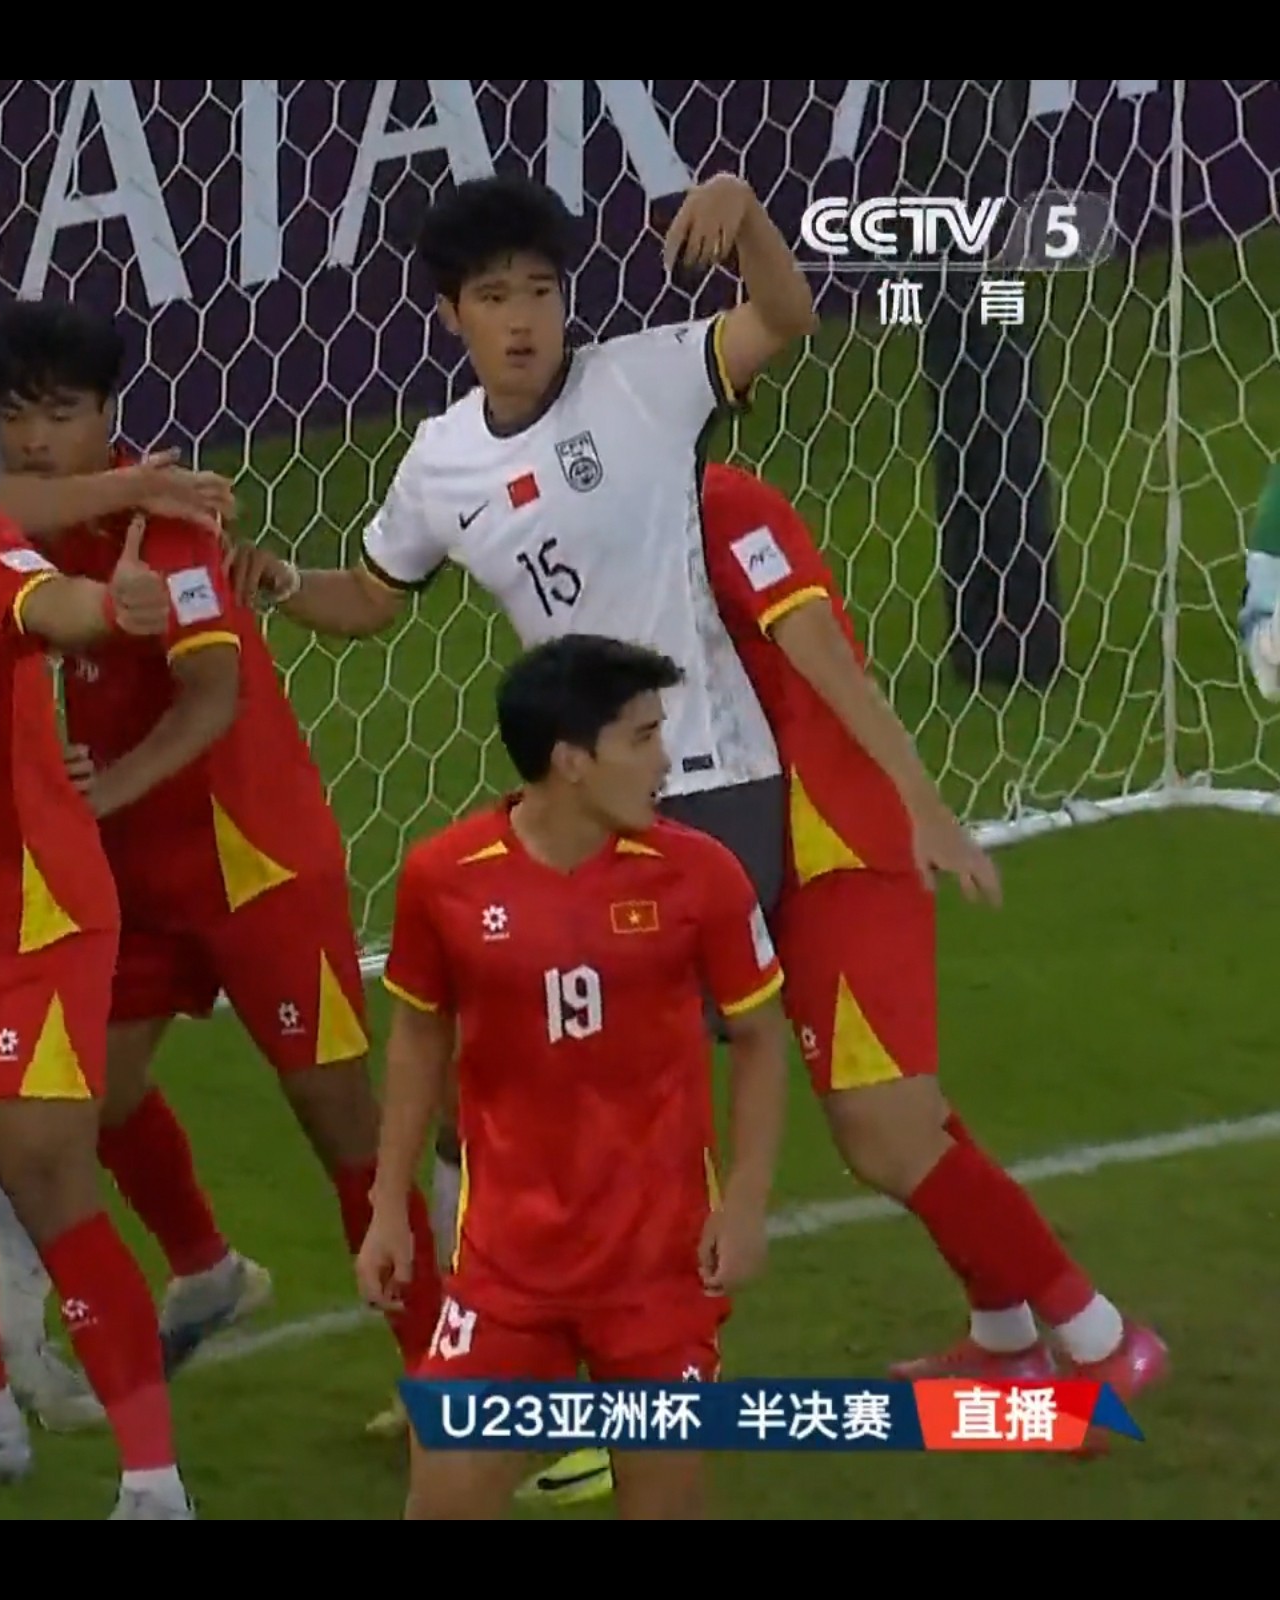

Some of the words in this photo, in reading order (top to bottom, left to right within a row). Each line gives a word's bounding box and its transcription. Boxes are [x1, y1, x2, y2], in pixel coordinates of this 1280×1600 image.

[516, 537, 582, 617] 15
[544, 963, 603, 1045] 19
[428, 1294, 477, 1361] 19
